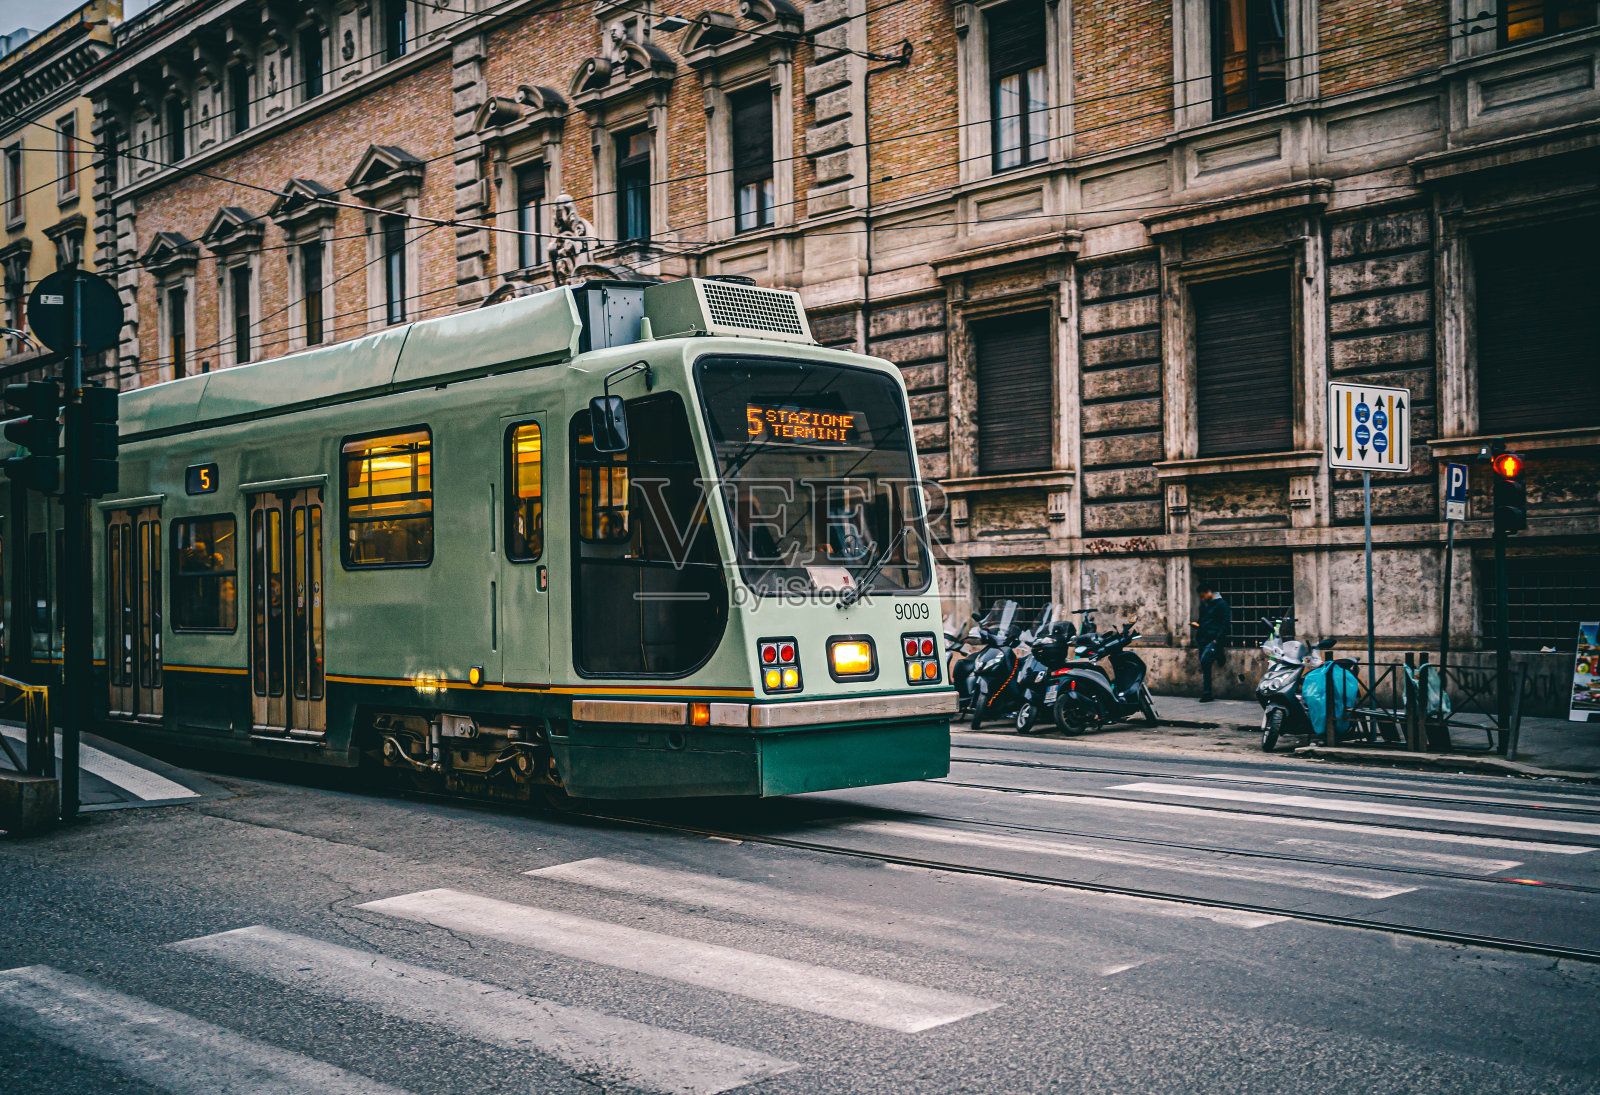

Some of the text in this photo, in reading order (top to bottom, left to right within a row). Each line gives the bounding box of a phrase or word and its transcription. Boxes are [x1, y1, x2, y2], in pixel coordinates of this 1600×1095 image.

[747, 407, 854, 434] 5 STAZIONE
[771, 423, 847, 441] TERMINI
[200, 469, 210, 489] 5
[1451, 467, 1463, 497] P
[894, 602, 930, 620] 9009
